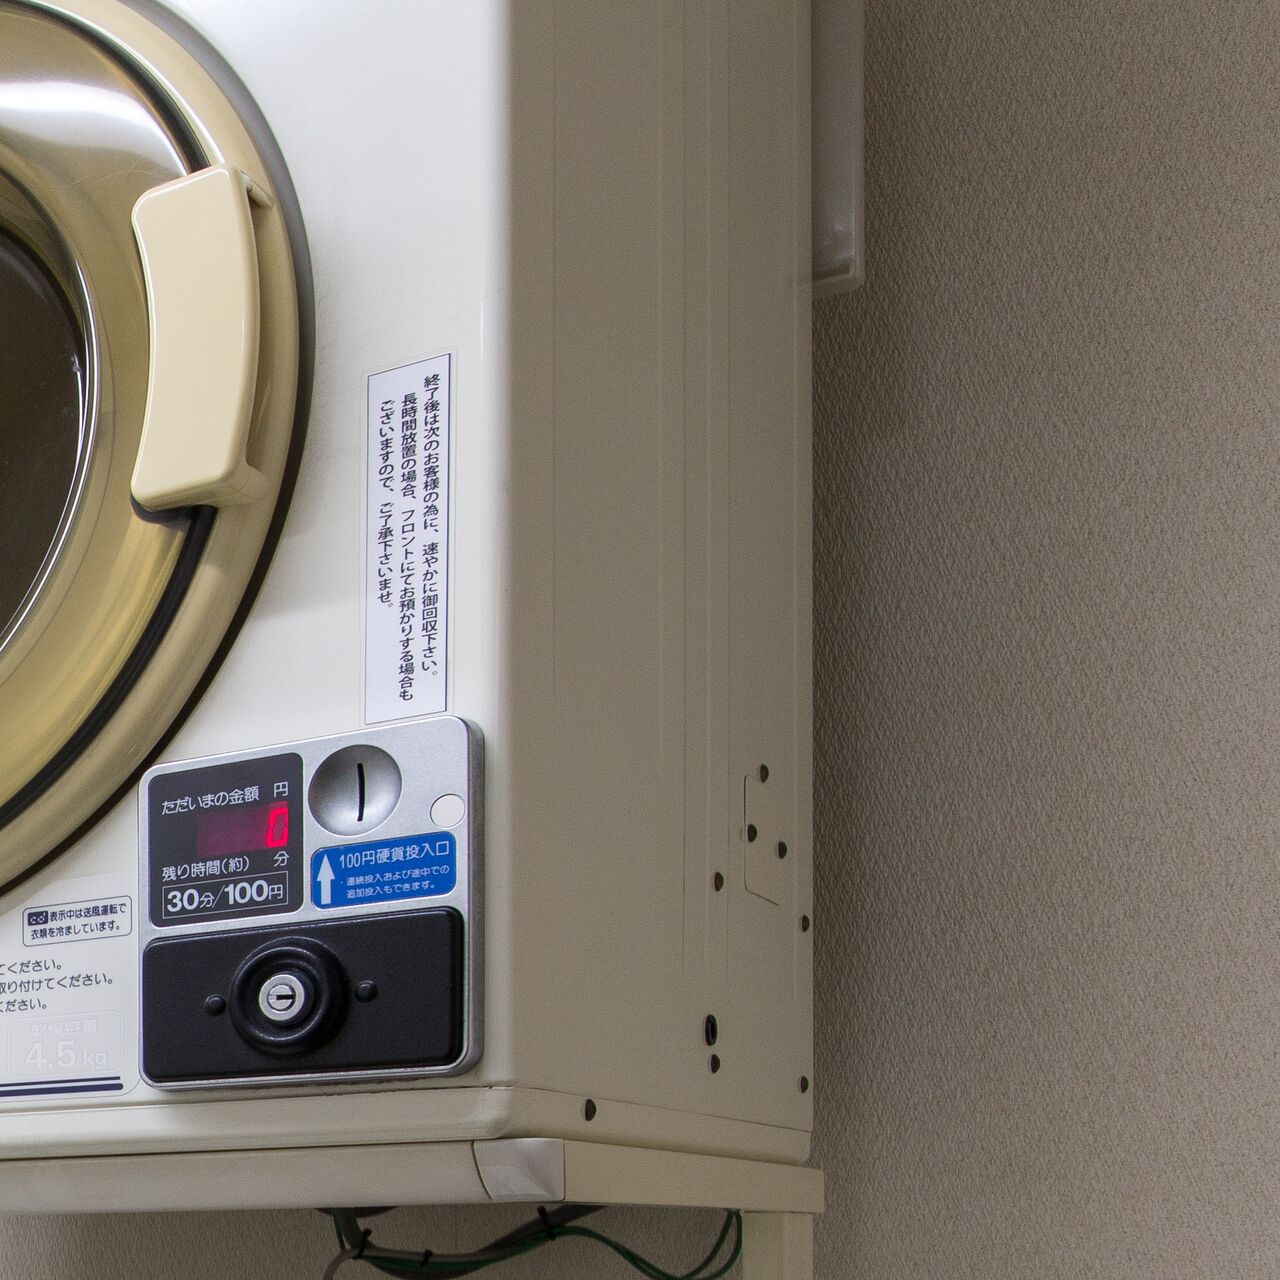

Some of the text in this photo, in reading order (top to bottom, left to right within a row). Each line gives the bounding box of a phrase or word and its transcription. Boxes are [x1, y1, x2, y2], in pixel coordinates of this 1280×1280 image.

[376, 399, 395, 609] ございますので、ご了承下さいませ。
[421, 373, 441, 676] 終了後は次のお客様の為に、速やかに御回収下さい。
[398, 392, 418, 703] 長時間放置の場合、フロントにてお預かりする場合も
[161, 781, 289, 815] ただいまの金額 円
[265, 806, 288, 848] 0
[162, 852, 289, 882] 残り時間(約) 分
[339, 841, 450, 869] 100円硬貨投入口
[346, 865, 450, 887] 連続投入および途中での
[346, 880, 436, 899] 追加投入もできます。
[166, 879, 284, 913] 30分/100円
[50, 903, 127, 922] 表示中は送風運転で
[31, 921, 121, 940] 衣類を冷ましています。
